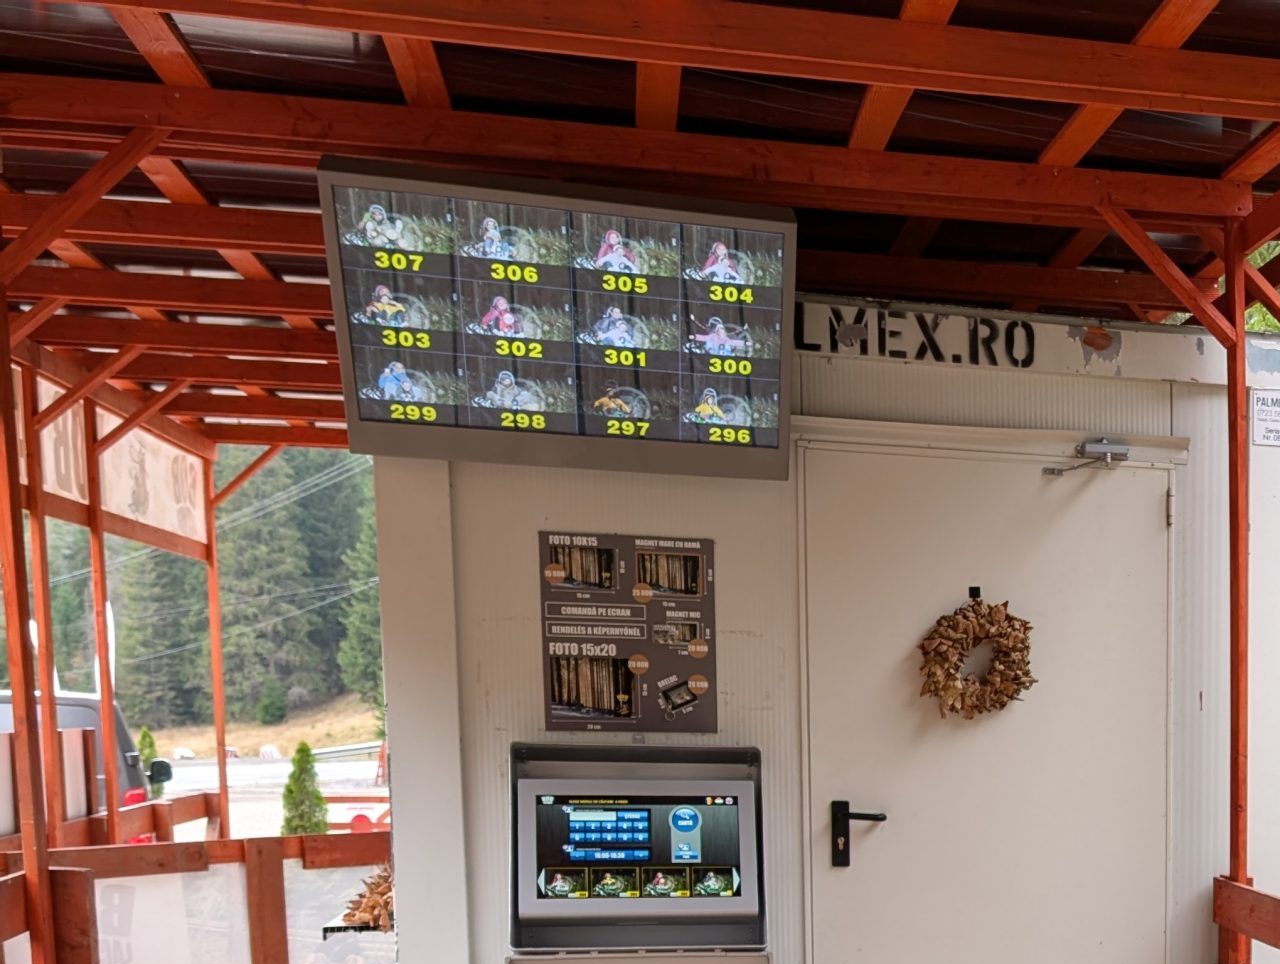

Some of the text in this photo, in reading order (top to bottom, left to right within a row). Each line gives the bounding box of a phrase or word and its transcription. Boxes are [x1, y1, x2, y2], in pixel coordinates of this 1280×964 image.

[375, 252, 423, 271] 307
[491, 263, 538, 282] 306
[602, 275, 647, 293] 305
[710, 285, 753, 303] 304
[383, 330, 430, 348] 303
[496, 340, 542, 358] 302
[605, 349, 645, 366] 301
[709, 358, 751, 374] 300
[390, 404, 436, 421] 299
[501, 412, 545, 428] 298
[607, 420, 649, 435] 297
[709, 428, 750, 443] 296
[549, 535, 598, 547] FOTO 10X15
[561, 606, 631, 616] COMANDĂ PE ECRAN
[587, 626, 592, 635] A
[549, 642, 616, 656] FOTO 15x20
